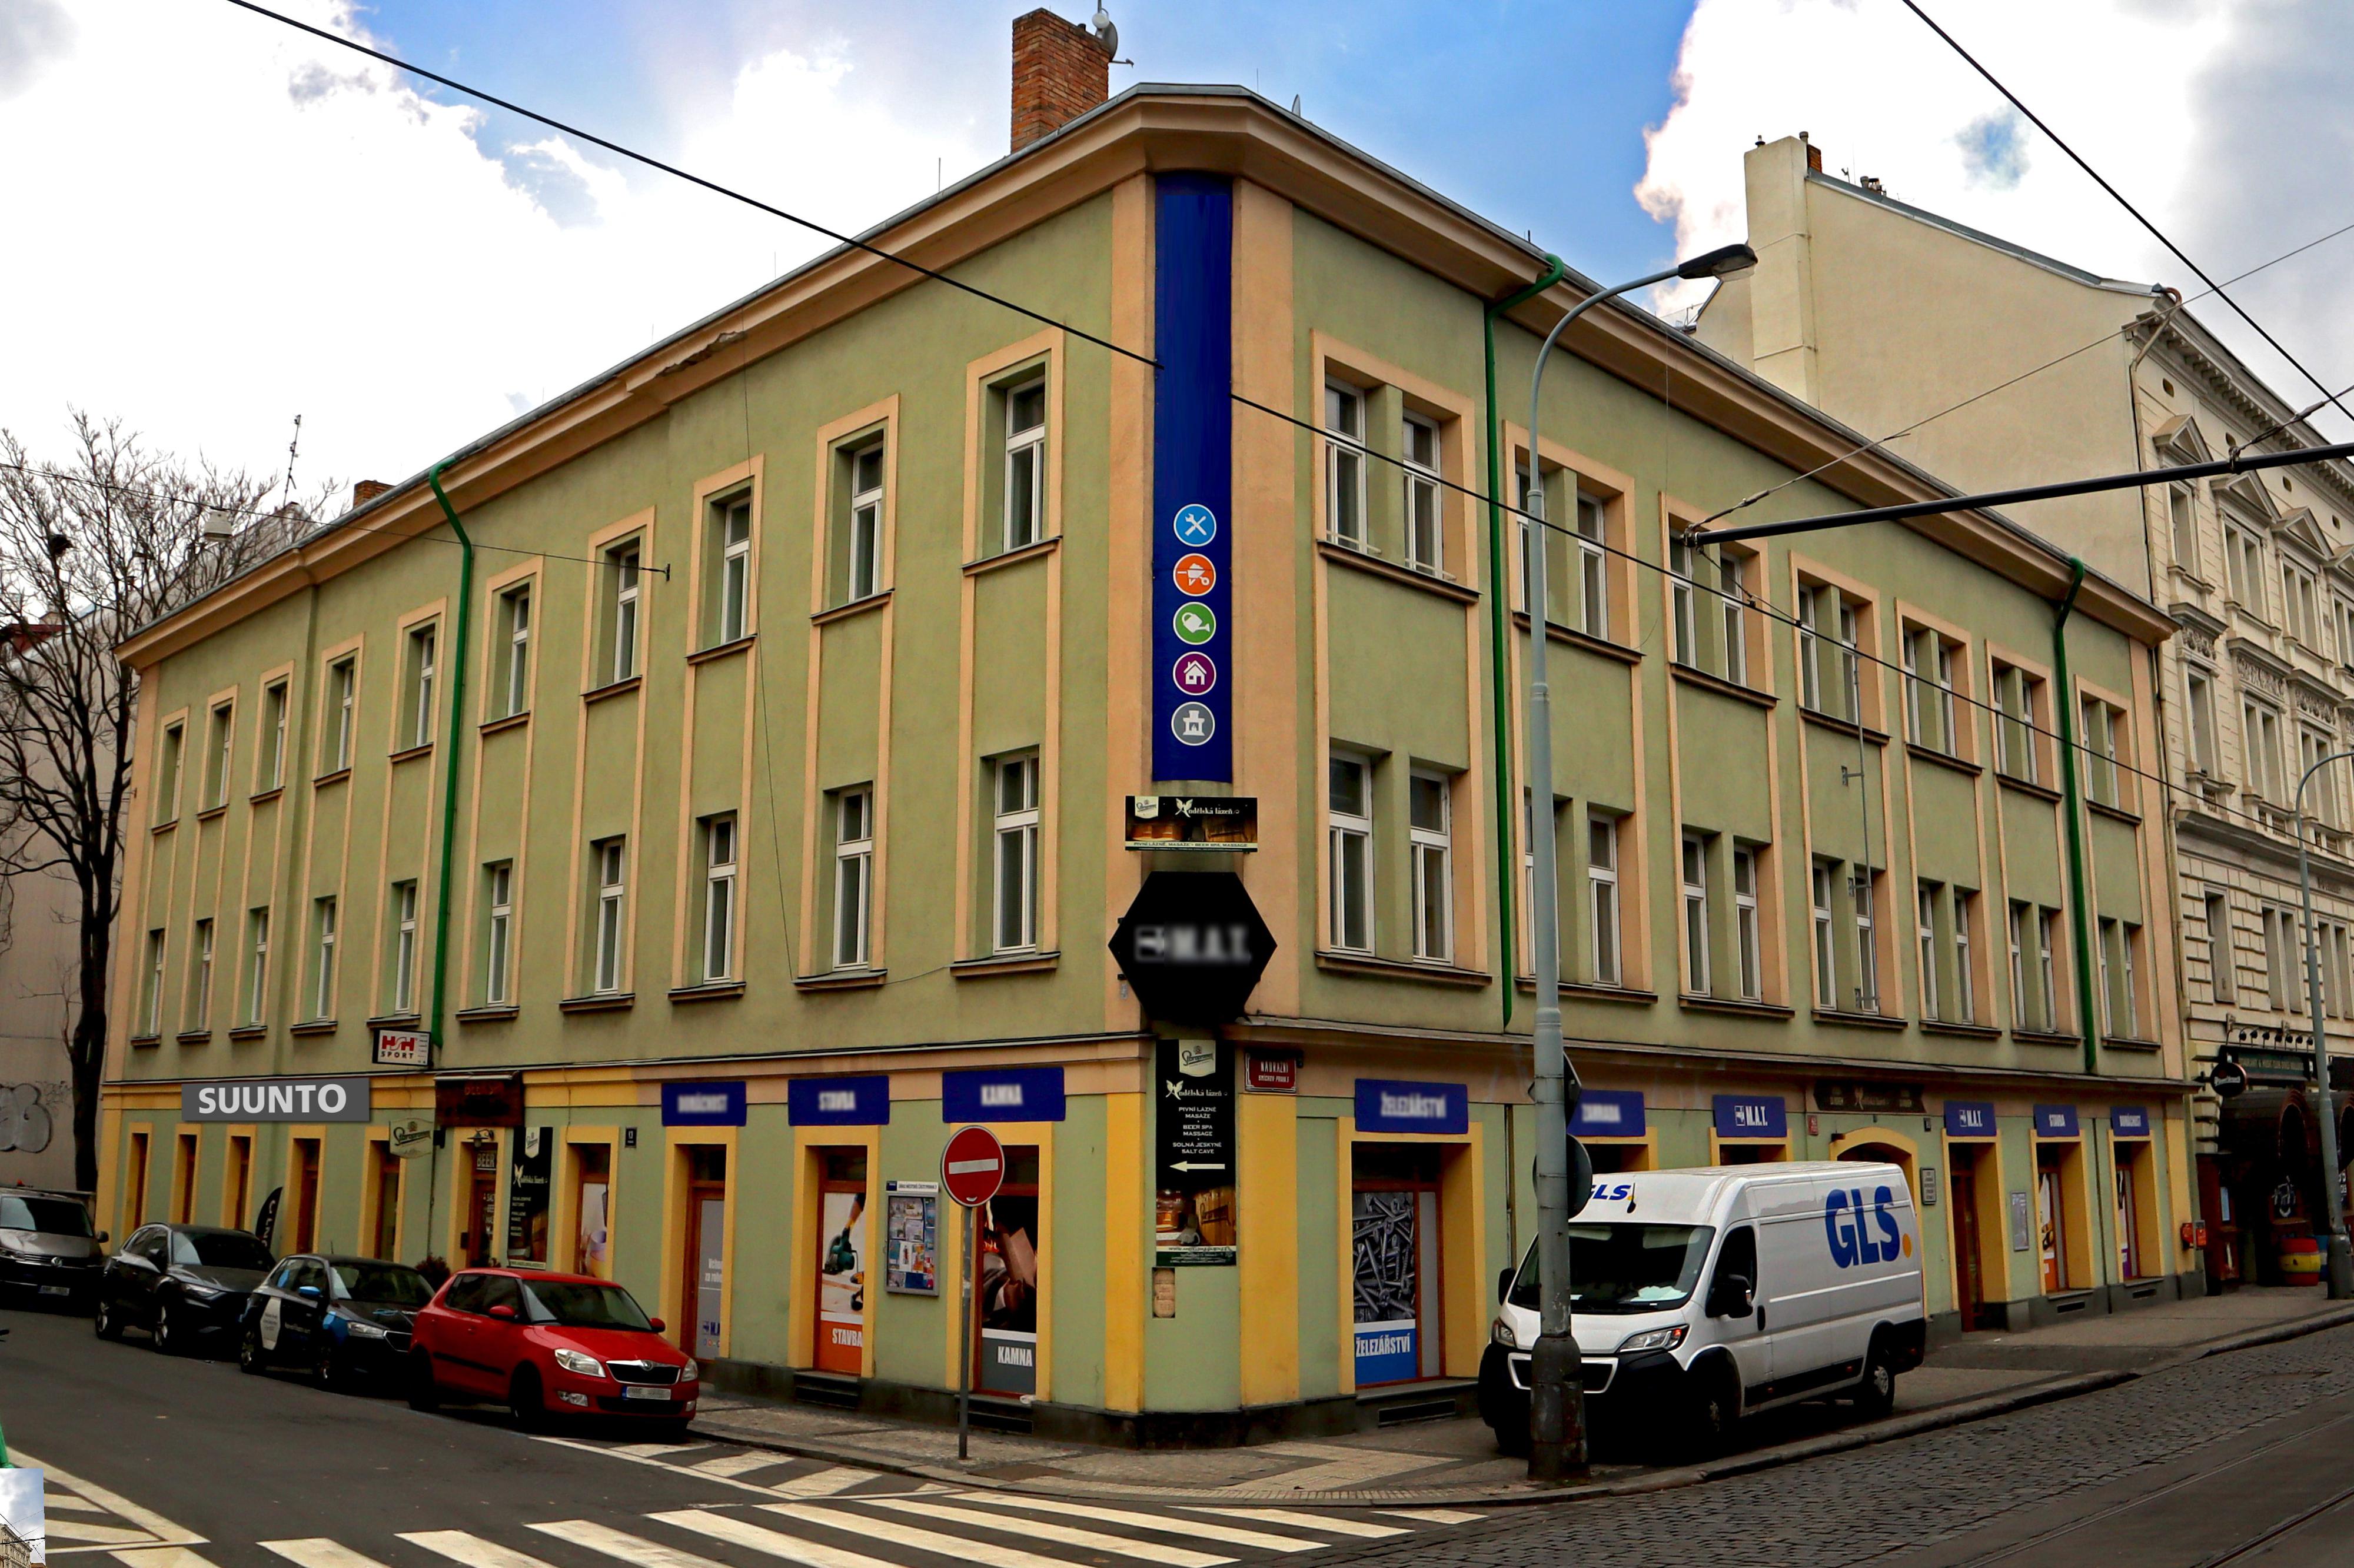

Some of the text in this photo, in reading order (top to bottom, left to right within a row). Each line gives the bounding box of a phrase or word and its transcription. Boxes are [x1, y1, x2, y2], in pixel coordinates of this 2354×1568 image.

[381, 1051, 414, 1059] SPORT
[198, 1084, 347, 1114] SUUNTO
[477, 1153, 495, 1167] BEER
[1591, 1184, 1631, 1200] LS
[1825, 1185, 1900, 1269] GLS
[832, 1327, 862, 1347] STAVBA
[1355, 1332, 1411, 1358] ŽELEZÁŘSTVÍ
[998, 1346, 1033, 1367] KAMNA
